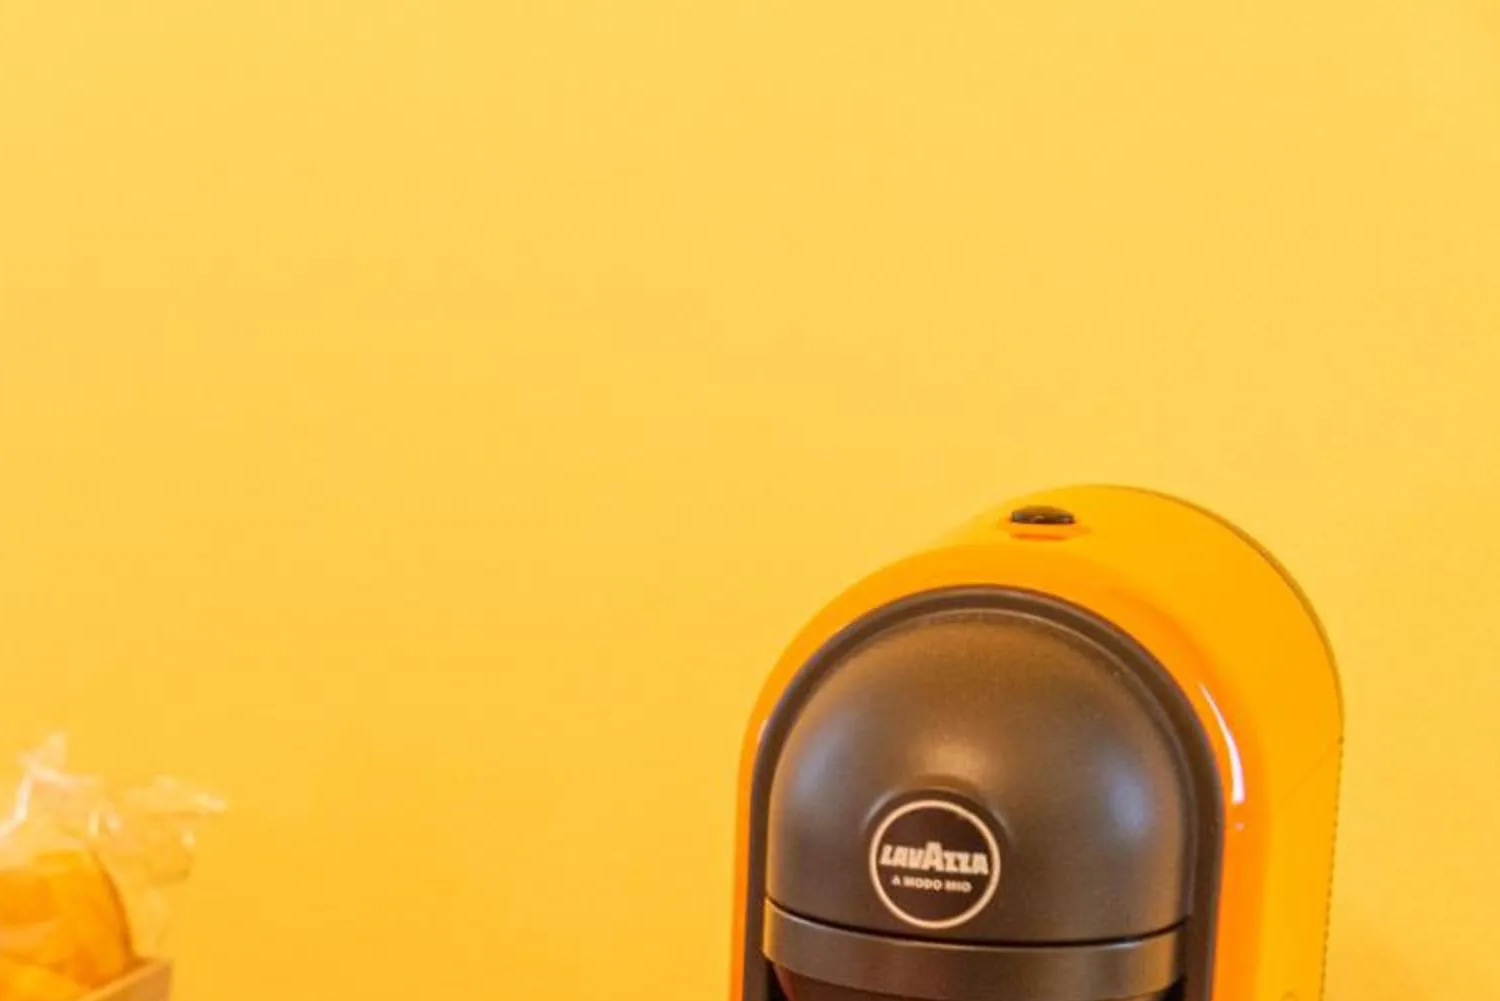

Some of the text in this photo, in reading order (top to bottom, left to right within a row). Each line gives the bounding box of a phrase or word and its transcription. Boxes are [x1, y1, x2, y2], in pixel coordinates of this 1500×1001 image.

[879, 841, 989, 875] LAVAZZA
[891, 875, 973, 893] A MODO MIO
